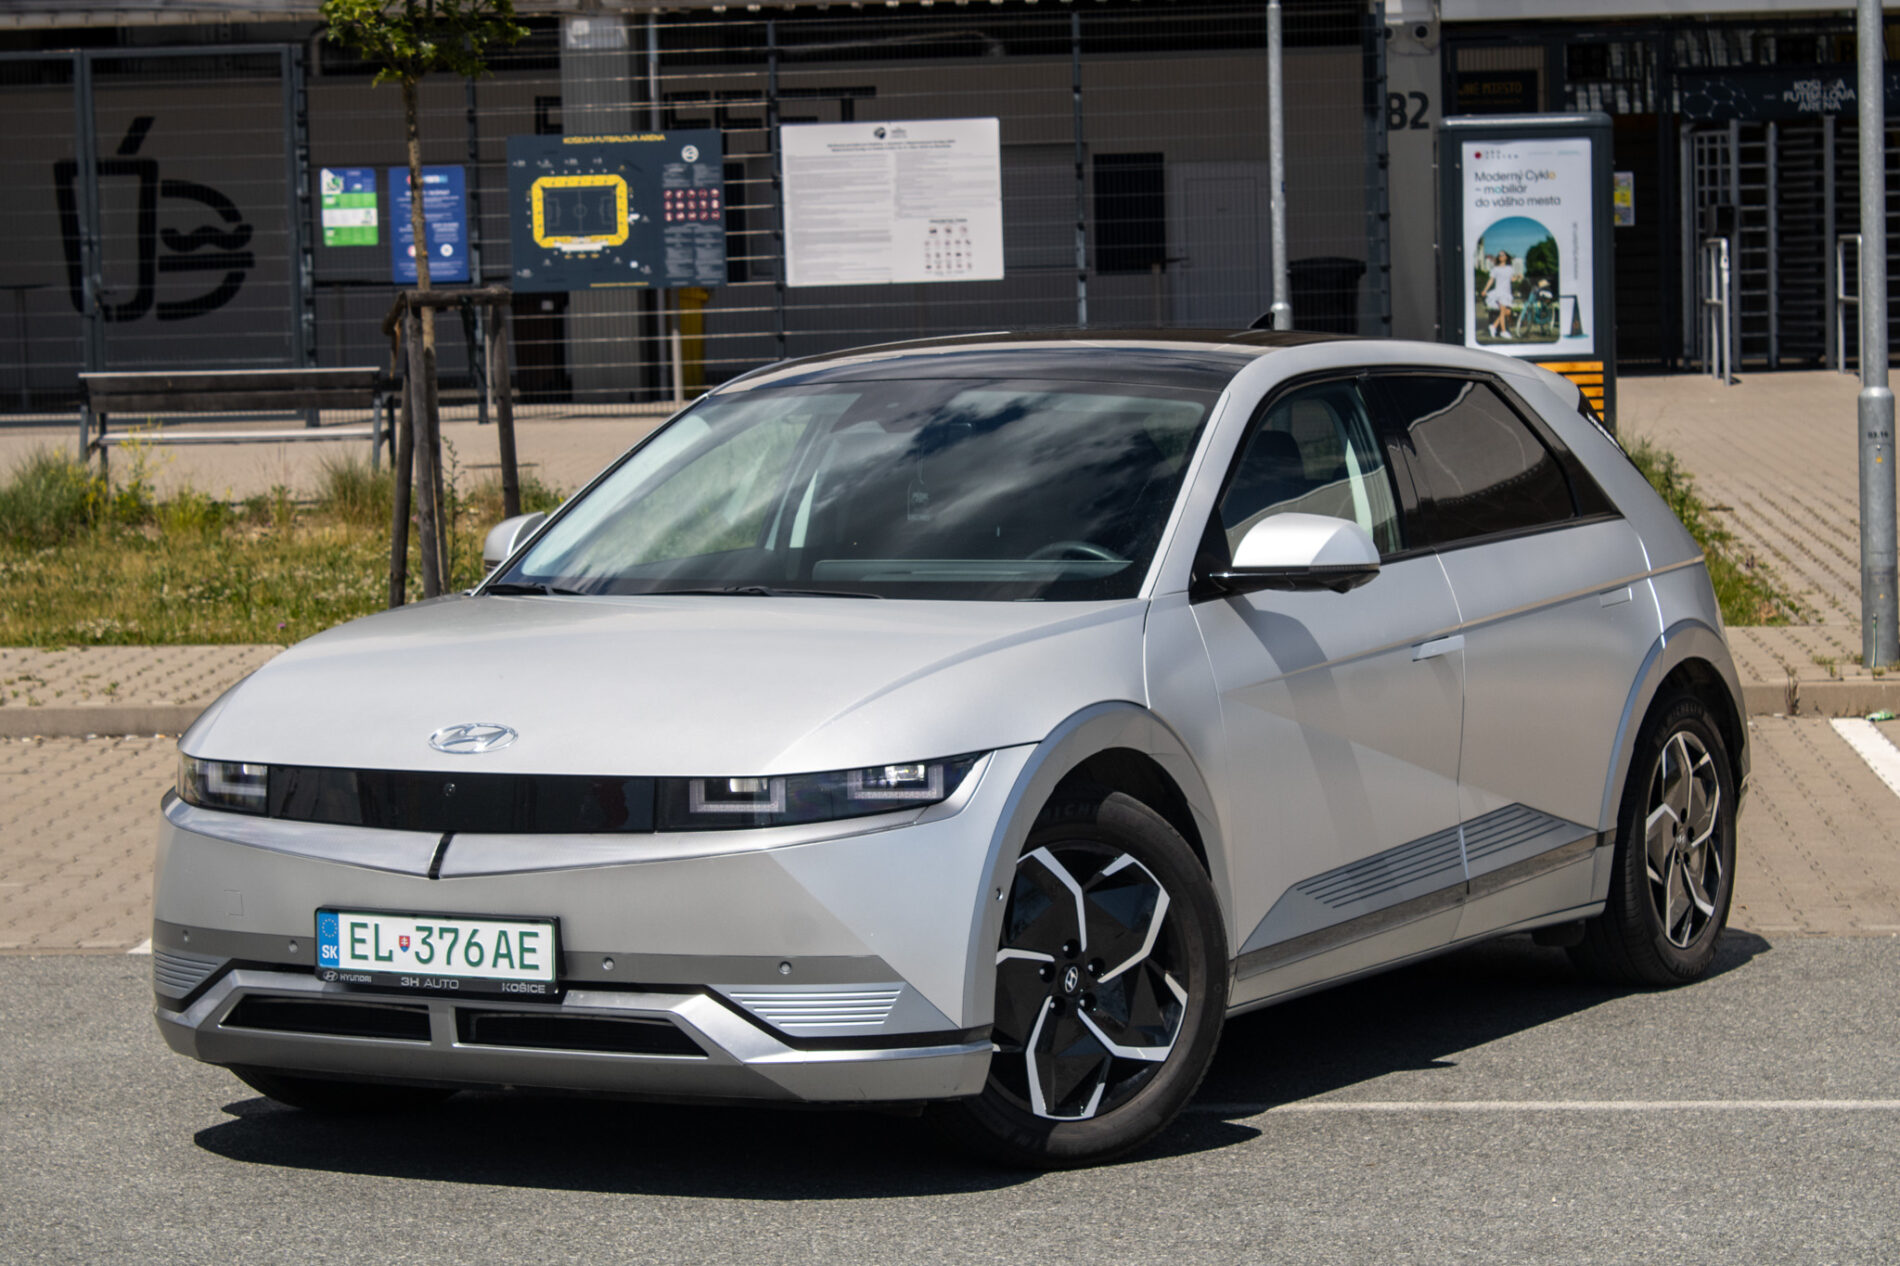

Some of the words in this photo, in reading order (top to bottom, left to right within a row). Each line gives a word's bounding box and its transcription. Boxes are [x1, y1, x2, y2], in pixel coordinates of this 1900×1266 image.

[1525, 169, 1556, 182] Cyklo
[1475, 198, 1490, 207] do
[1526, 196, 1562, 206] mesta
[350, 921, 394, 962] EL
[321, 944, 338, 959] SK
[339, 973, 372, 983] HYUNDAI
[401, 976, 419, 987] 3H
[424, 978, 459, 990] AUTO
[502, 981, 546, 994] KOŠICE
